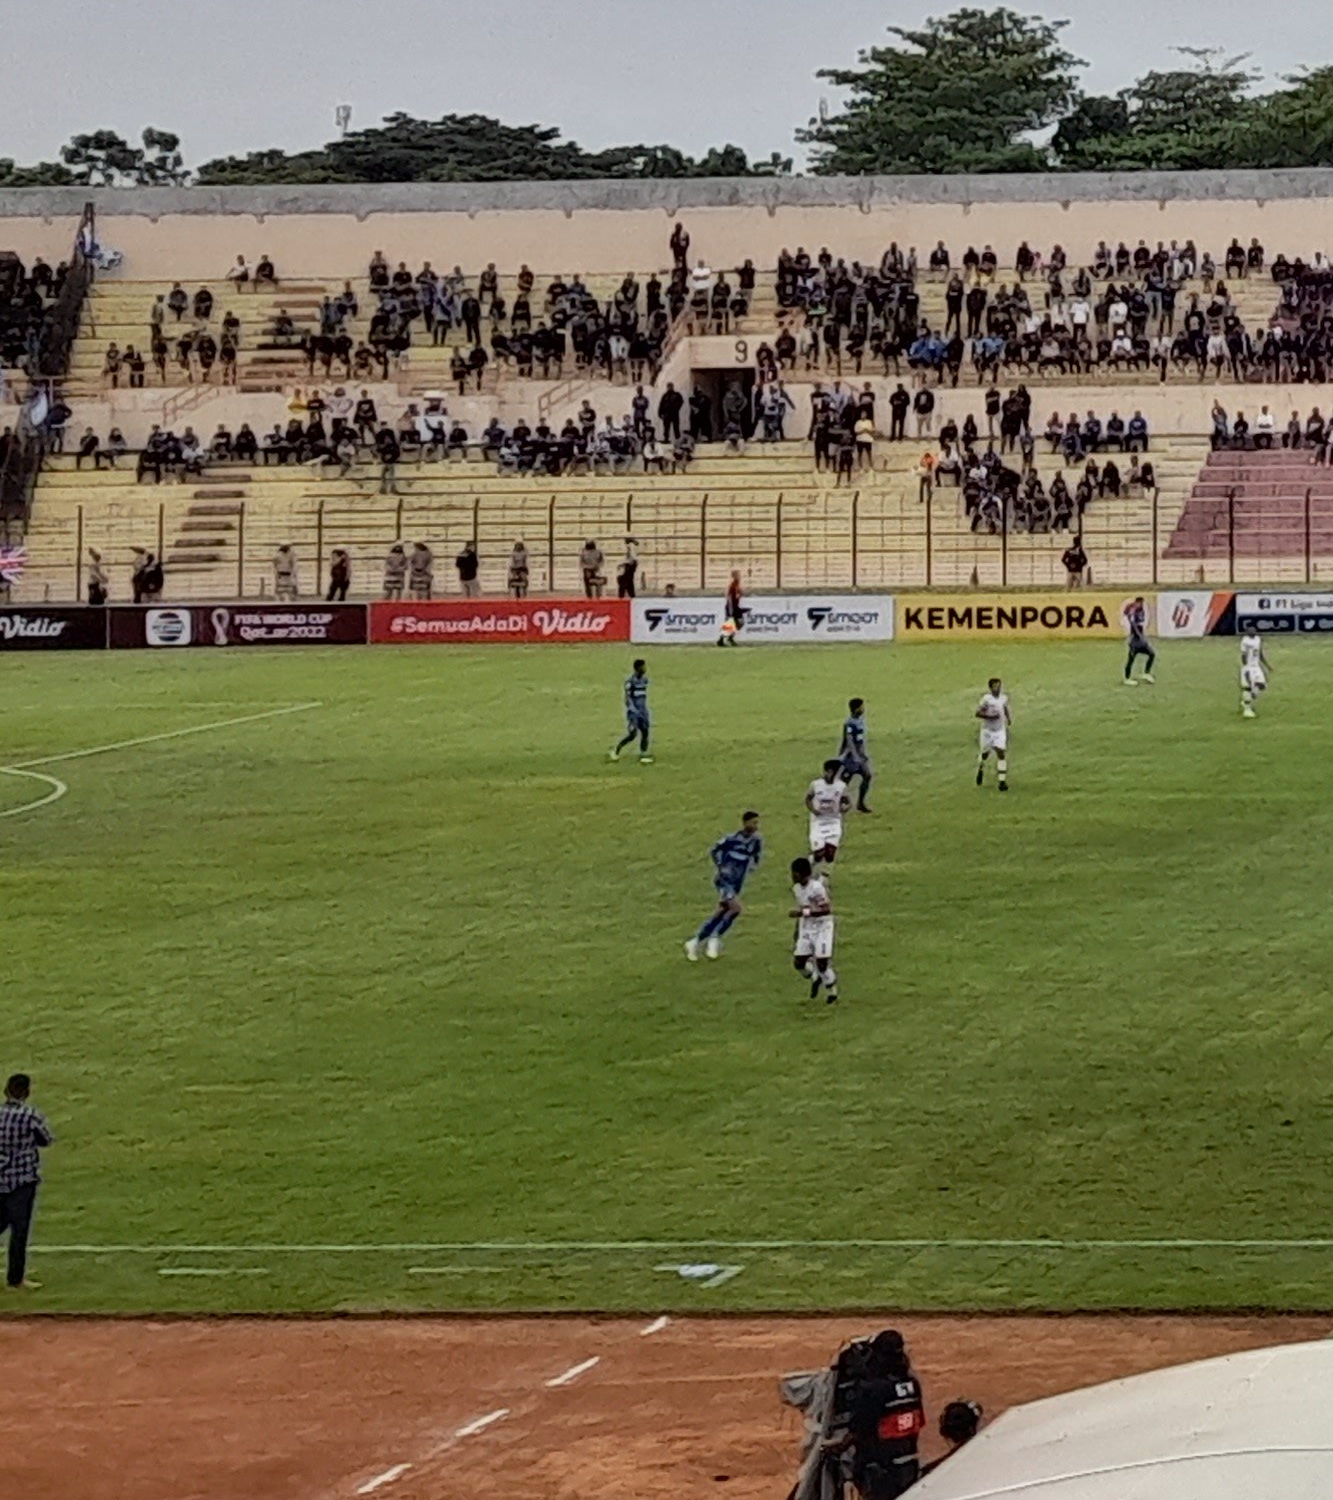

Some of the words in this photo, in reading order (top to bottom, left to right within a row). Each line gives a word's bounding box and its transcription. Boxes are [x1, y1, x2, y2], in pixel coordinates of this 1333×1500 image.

[735, 340, 749, 364] 9
[389, 615, 527, 633] #SemuaAdaDi
[532, 608, 611, 636] Vidio
[904, 605, 1109, 630] KEMENPORA
